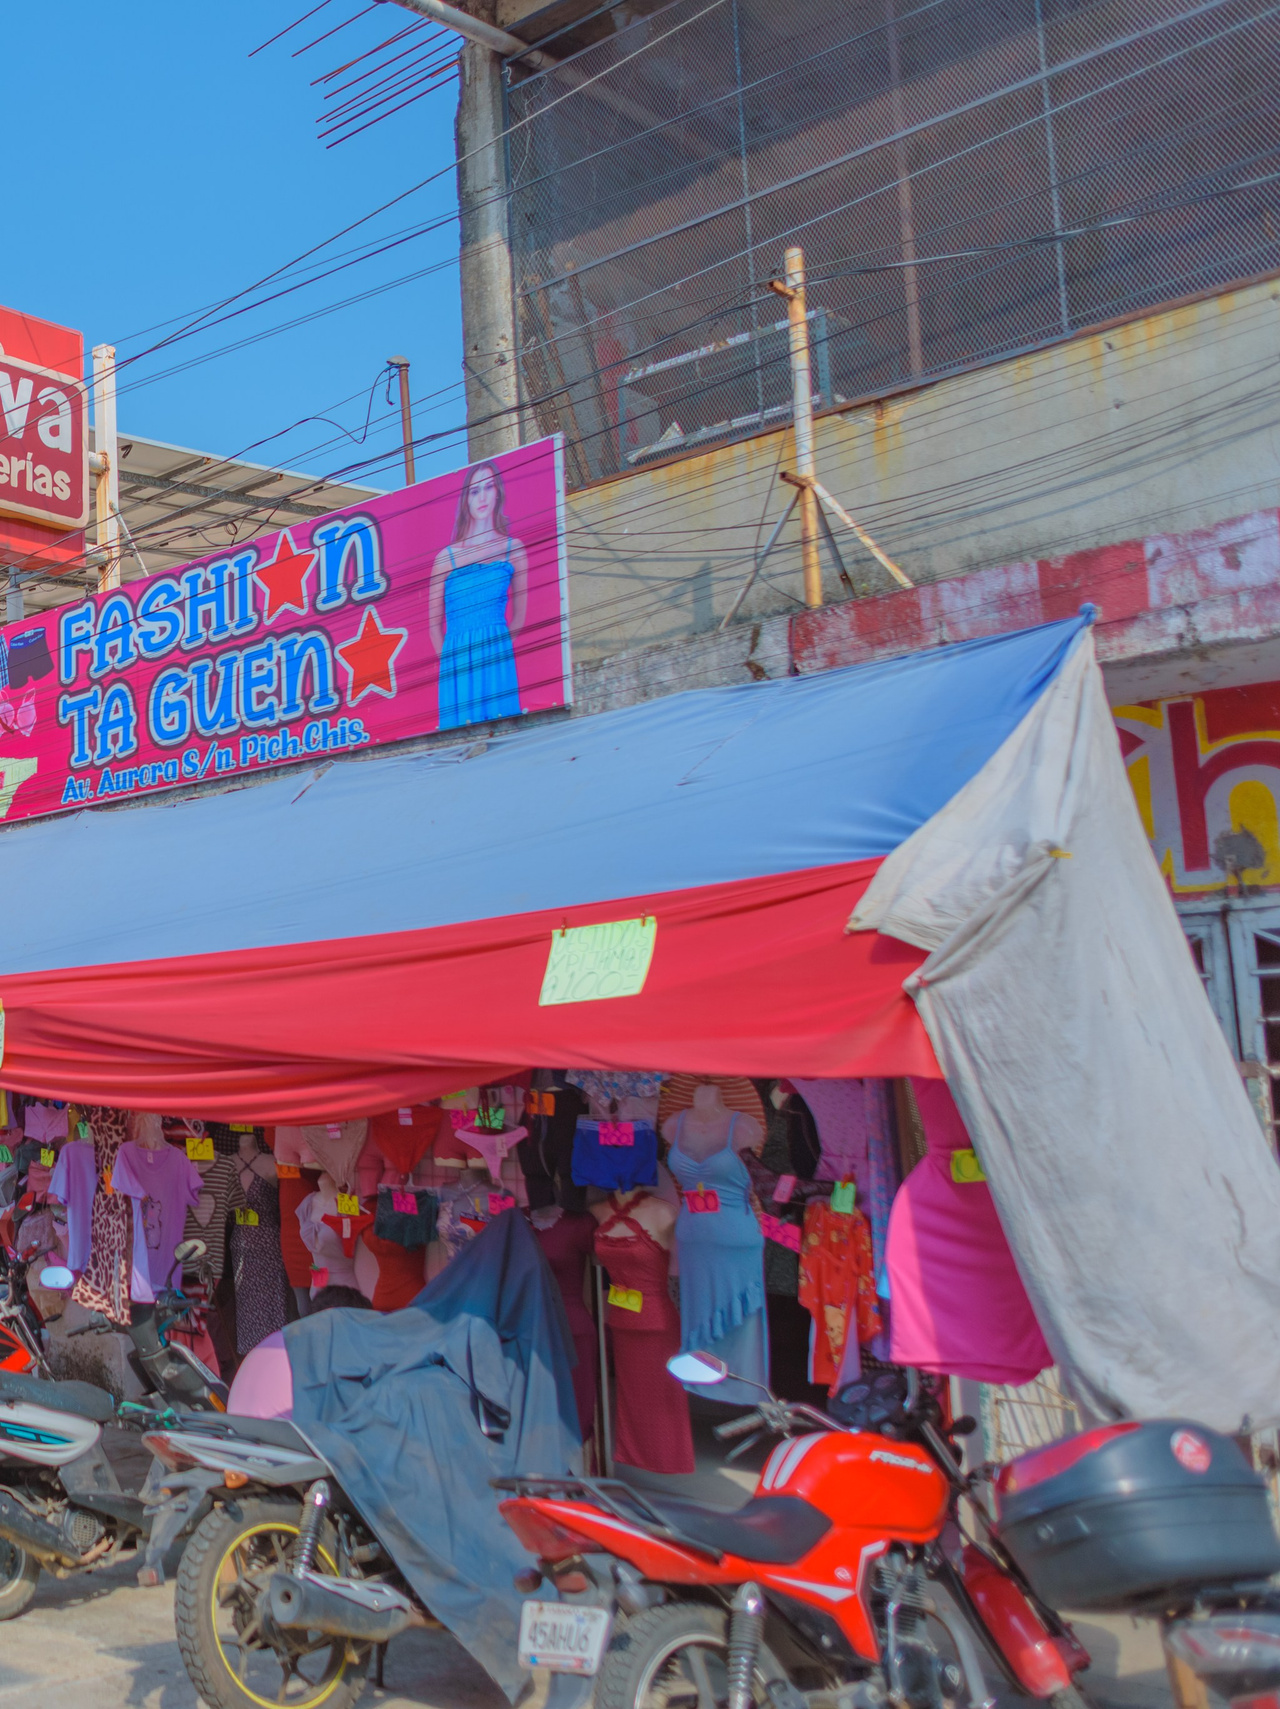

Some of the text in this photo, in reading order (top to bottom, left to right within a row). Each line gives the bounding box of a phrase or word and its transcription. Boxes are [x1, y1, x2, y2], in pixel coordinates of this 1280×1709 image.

[58, 682, 138, 767] TA
[60, 776, 94, 804] Av.
[97, 758, 178, 797] Aurora
